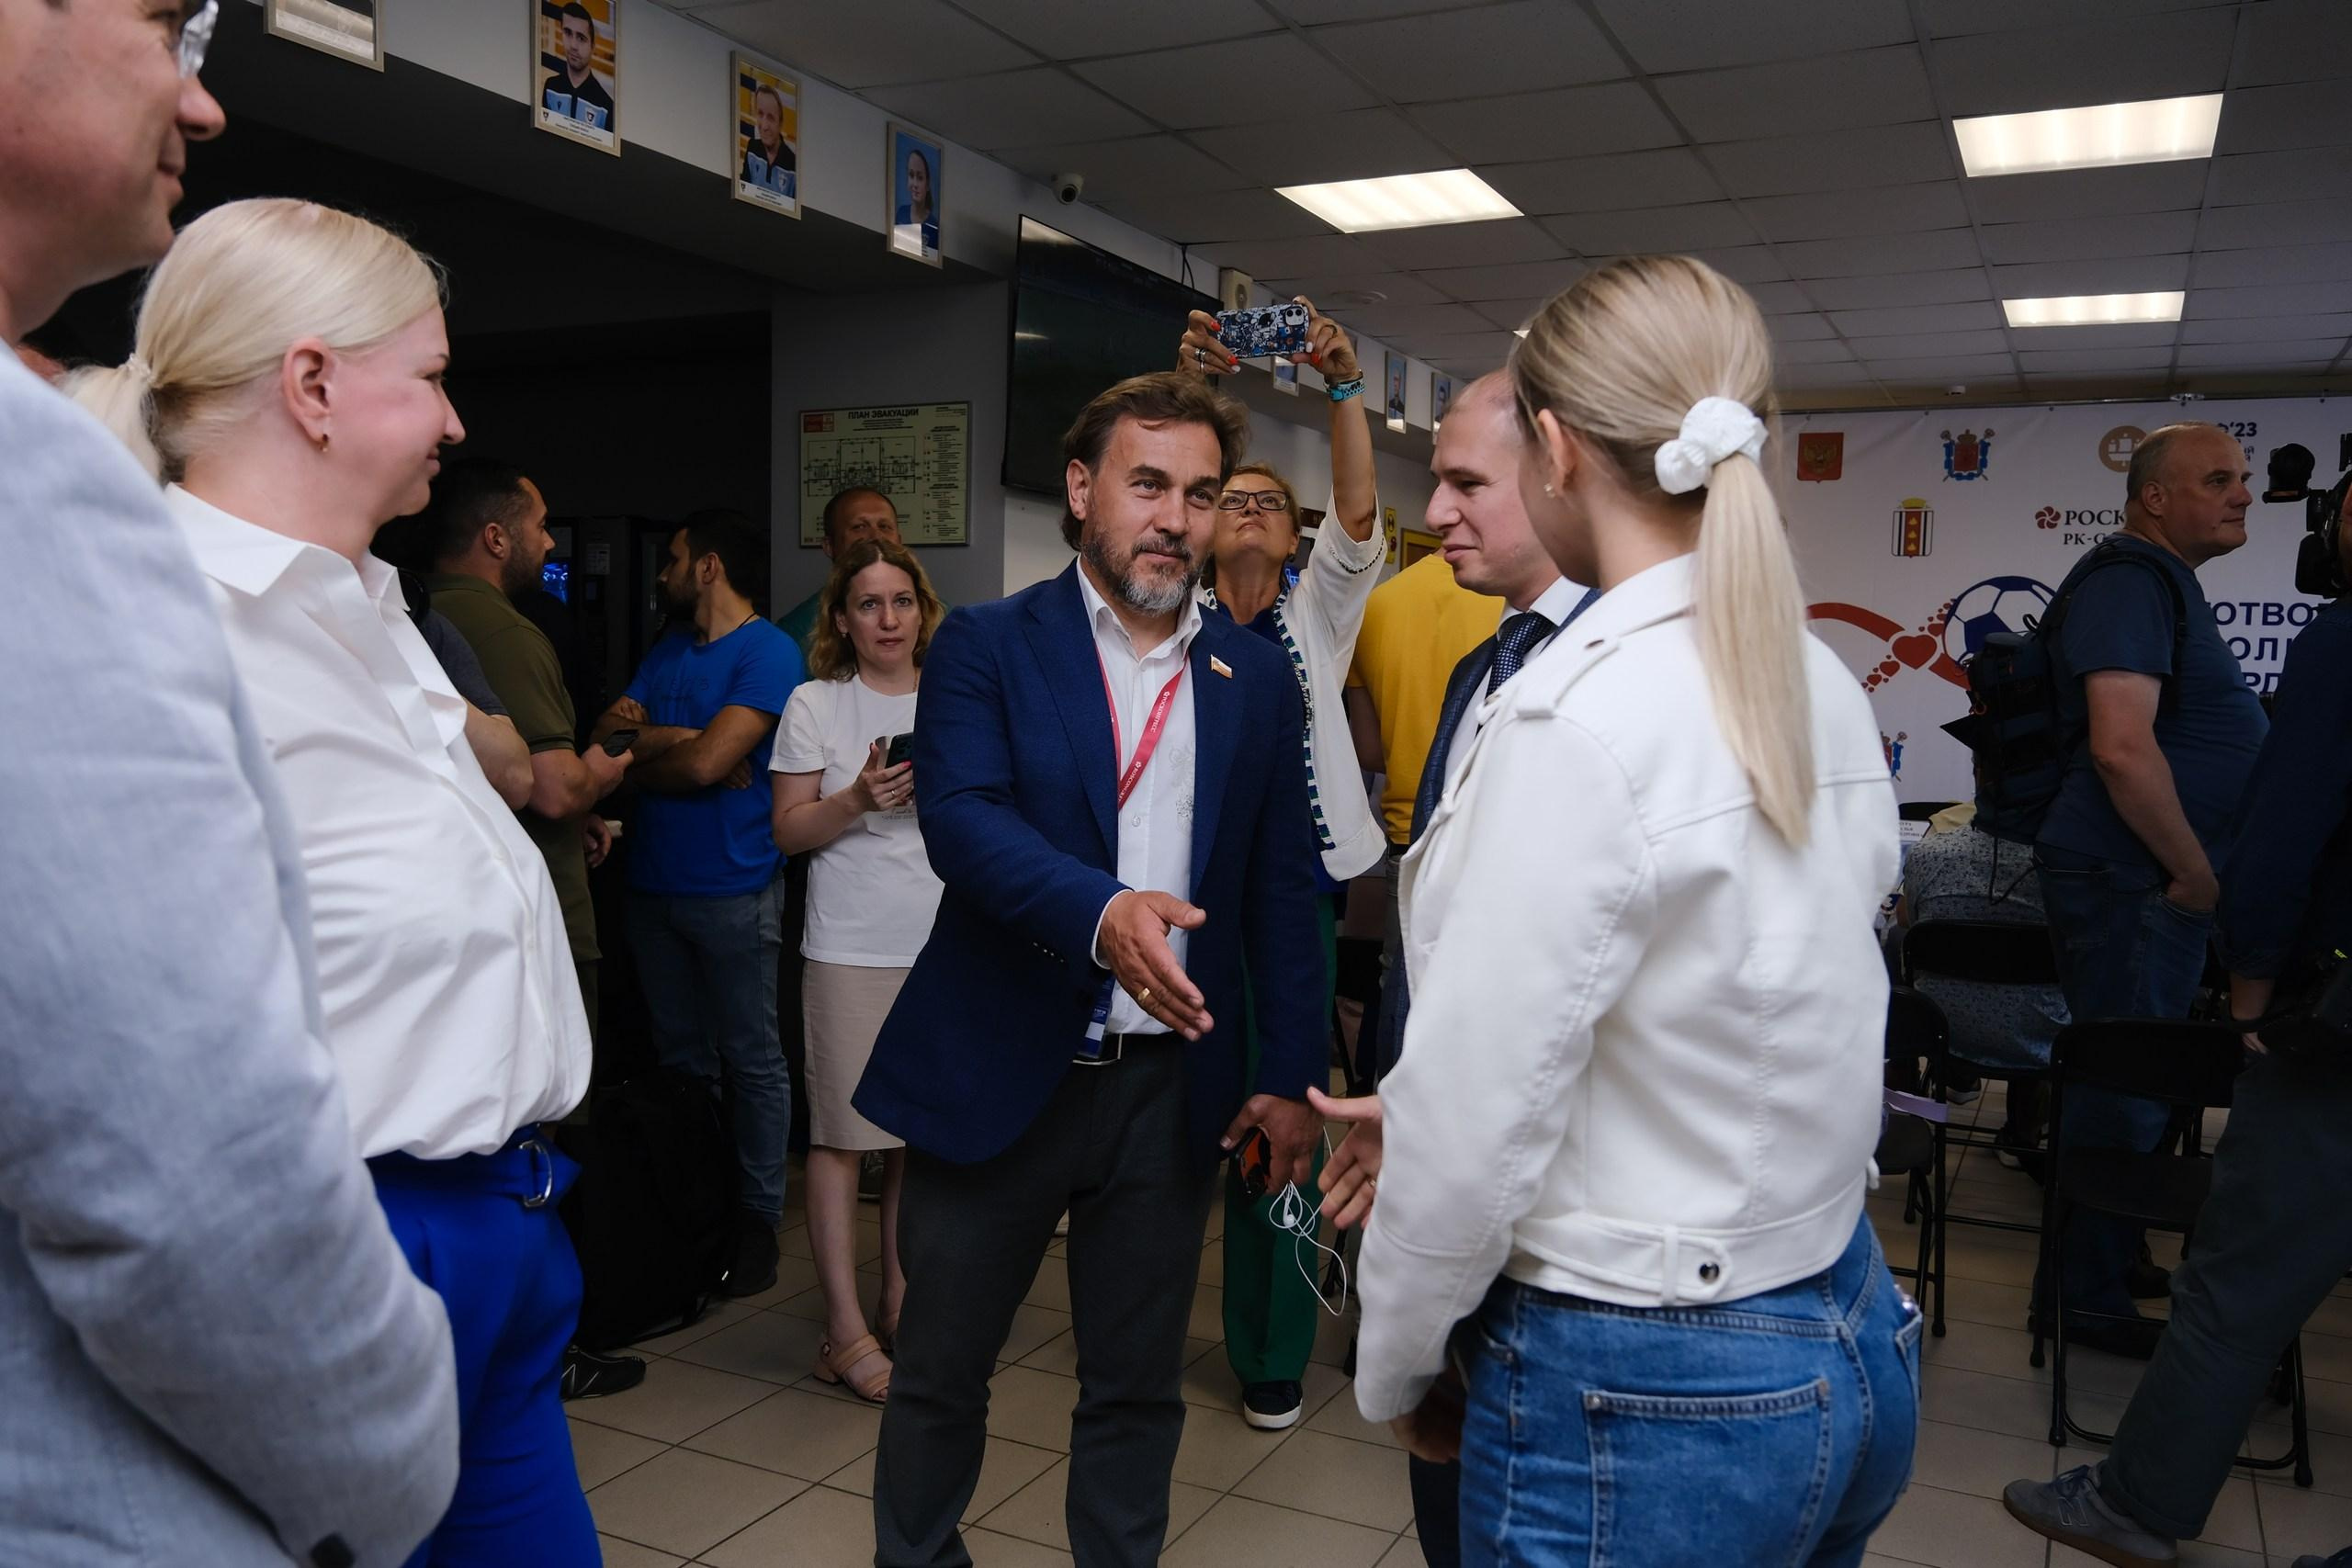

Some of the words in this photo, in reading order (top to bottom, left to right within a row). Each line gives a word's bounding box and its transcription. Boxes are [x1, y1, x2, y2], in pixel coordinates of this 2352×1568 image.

[848, 410, 870, 420] ПЛАН
[871, 408, 919, 419] ЭВАКУАЦИИ
[2207, 602, 2327, 626] ОТВО
[2227, 637, 2293, 661] ОЛ
